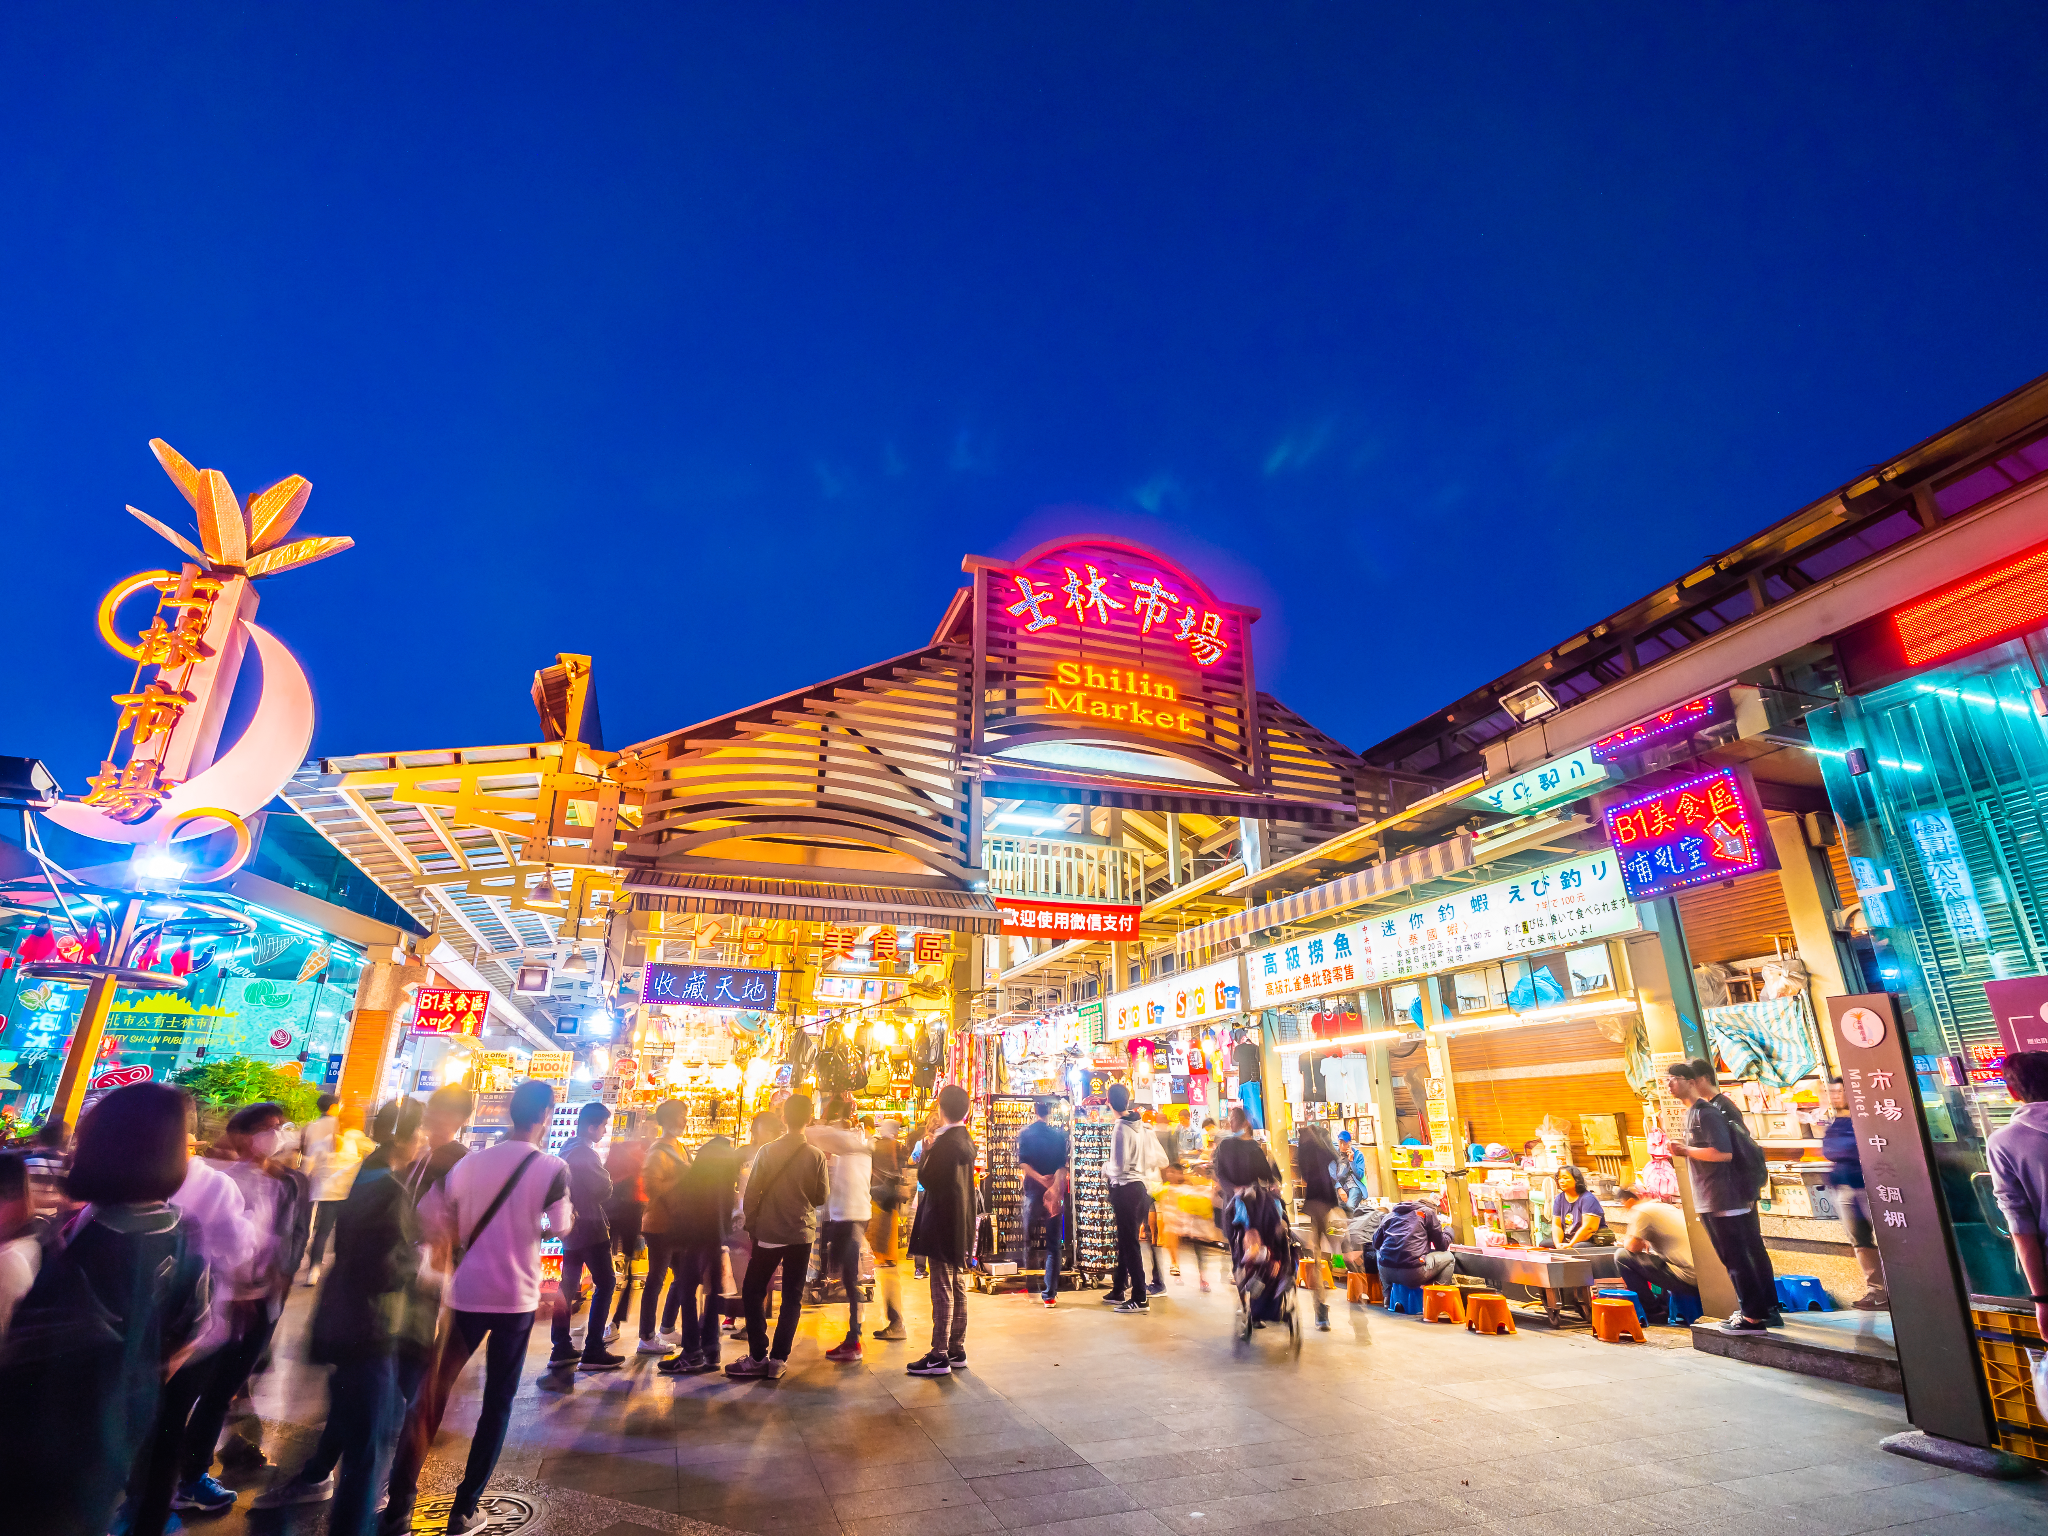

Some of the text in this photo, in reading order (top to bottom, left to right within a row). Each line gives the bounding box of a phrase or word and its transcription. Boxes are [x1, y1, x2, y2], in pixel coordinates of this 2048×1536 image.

[1006, 564, 1229, 666] 士林市場
[80, 562, 224, 826] 士林市場
[1057, 661, 1178, 702] Shilin
[1045, 686, 1190, 733] Market
[1615, 780, 1738, 845] B1美食區
[1628, 836, 1707, 884] 哺乳室
[997, 907, 1134, 932] 歡迎使用微信支付
[1380, 860, 1607, 938] 迷你釣蝦 えび釣り
[1262, 932, 1353, 977] 高級撈魚
[420, 992, 484, 1012] B1美食區
[653, 969, 768, 1003] 收藏天地
[1175, 978, 1226, 1019] Spot
[129, 1034, 161, 1044] SHI-LIN
[161, 1035, 192, 1045] PUBLIC
[416, 1016, 438, 1027] 入口
[1847, 1068, 1870, 1119] Market
[1867, 1068, 1904, 1122] 市場
